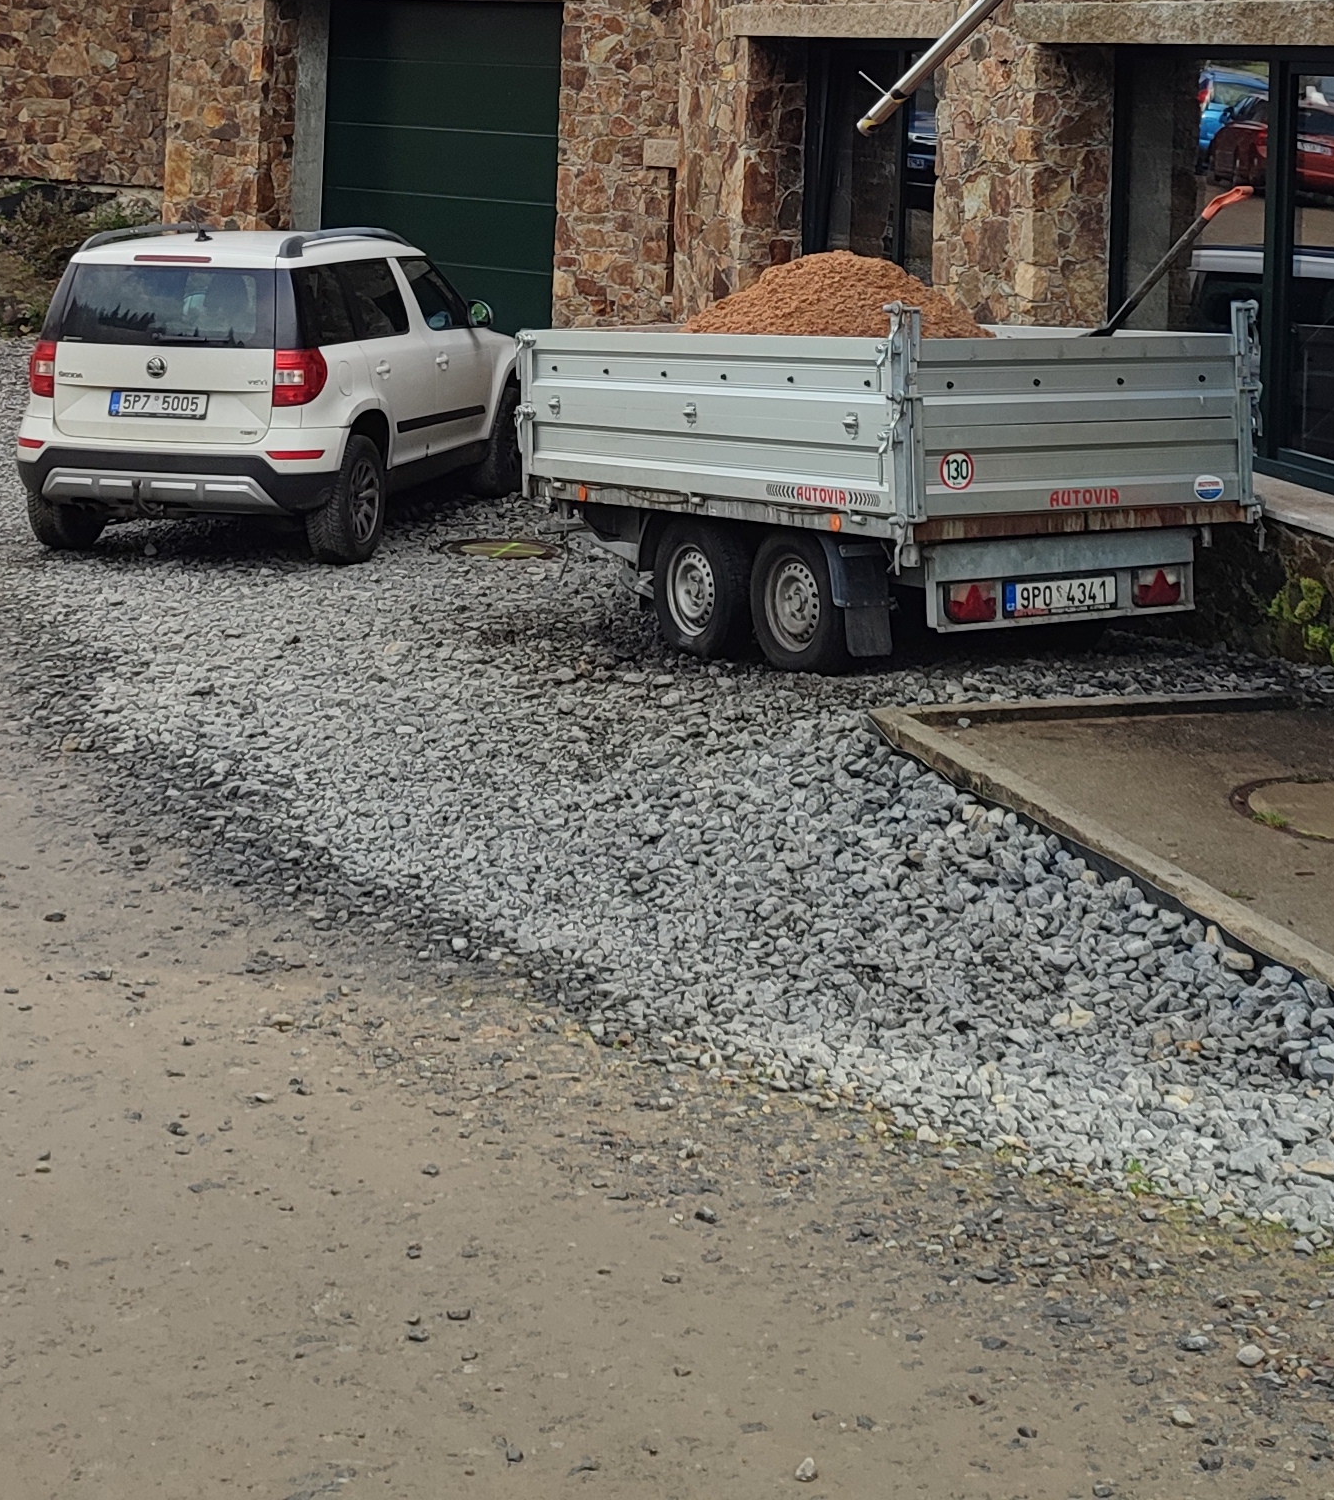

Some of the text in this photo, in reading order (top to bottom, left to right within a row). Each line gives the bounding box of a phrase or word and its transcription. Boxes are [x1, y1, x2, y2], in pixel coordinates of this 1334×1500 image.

[122, 393, 151, 411] 5P7
[161, 395, 200, 413] 5005
[945, 458, 969, 481] 130
[796, 485, 847, 506] AUTOVIA
[1049, 487, 1120, 508] AUTOVIA
[1020, 584, 1053, 609] 9P0
[1066, 579, 1107, 606] 4341
